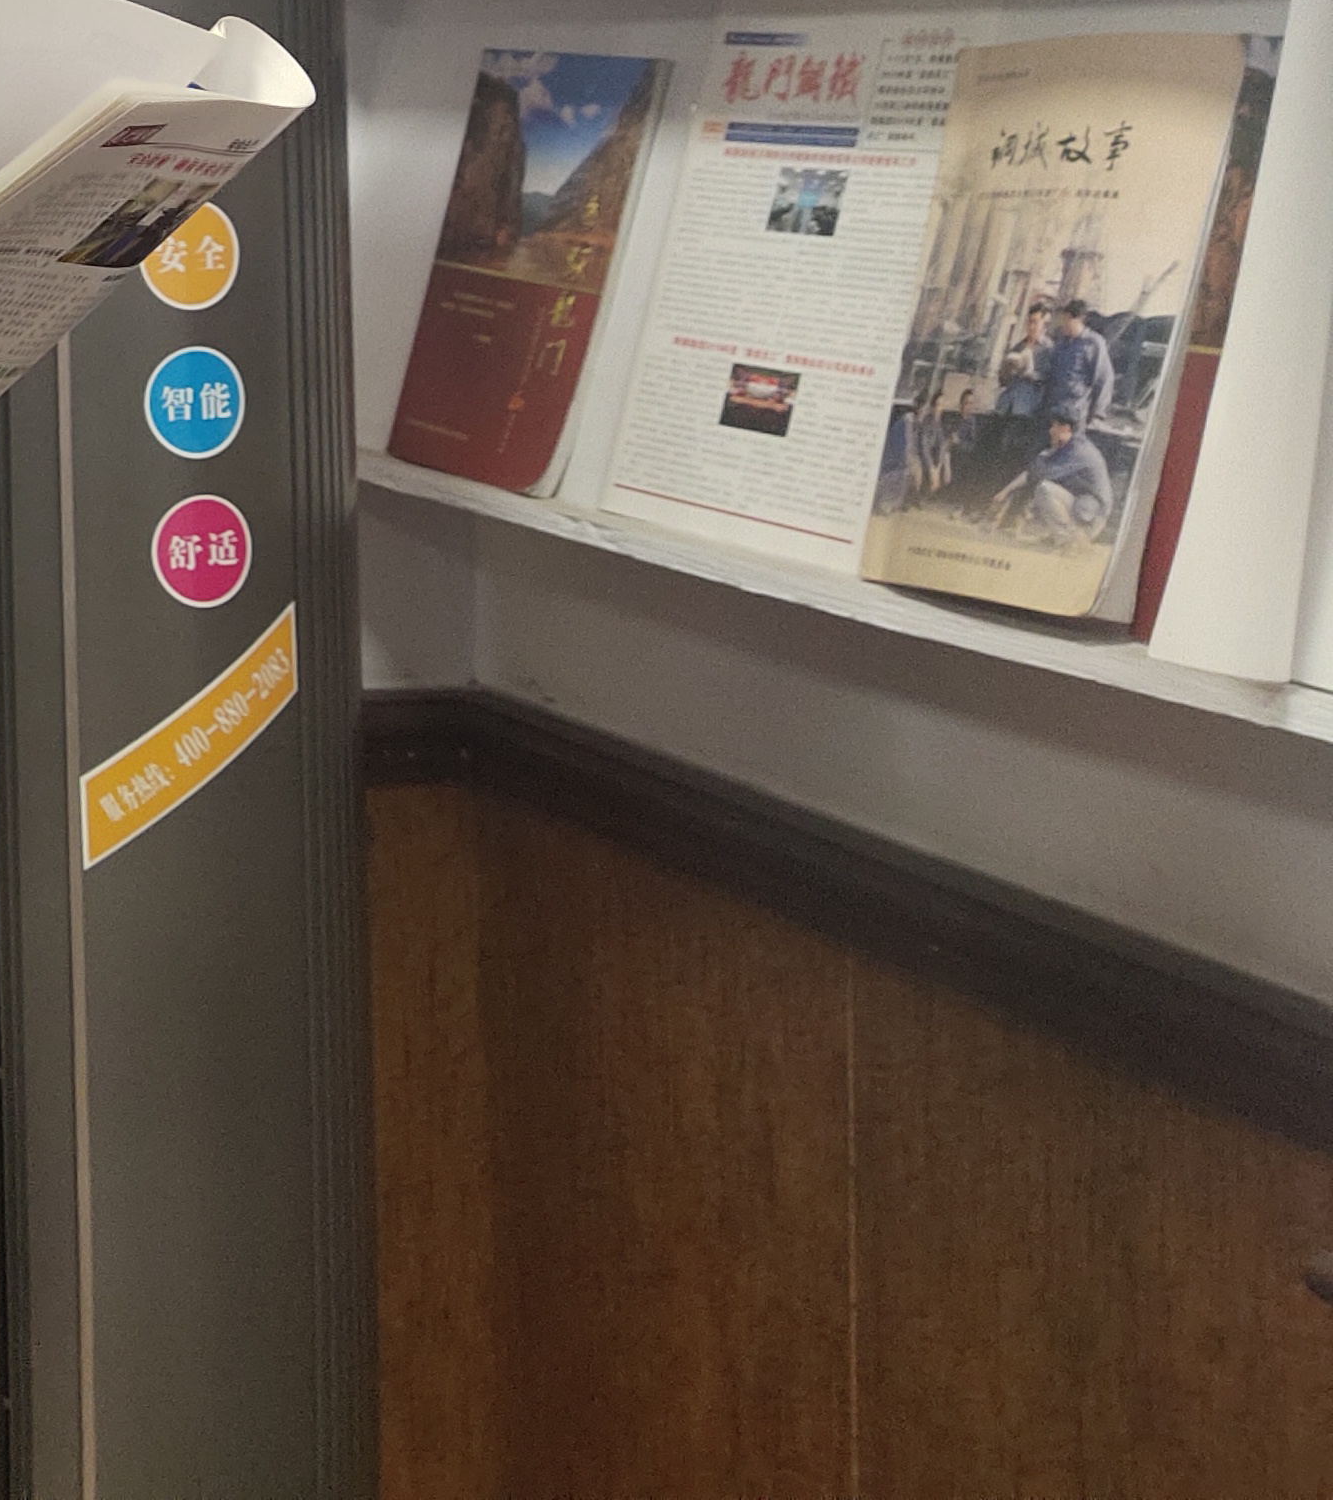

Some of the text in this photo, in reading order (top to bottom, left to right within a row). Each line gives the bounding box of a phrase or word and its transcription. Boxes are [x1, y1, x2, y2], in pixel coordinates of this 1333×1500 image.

[156, 233, 227, 274] 安全
[160, 380, 233, 423] 智能
[166, 528, 240, 573] 舒适
